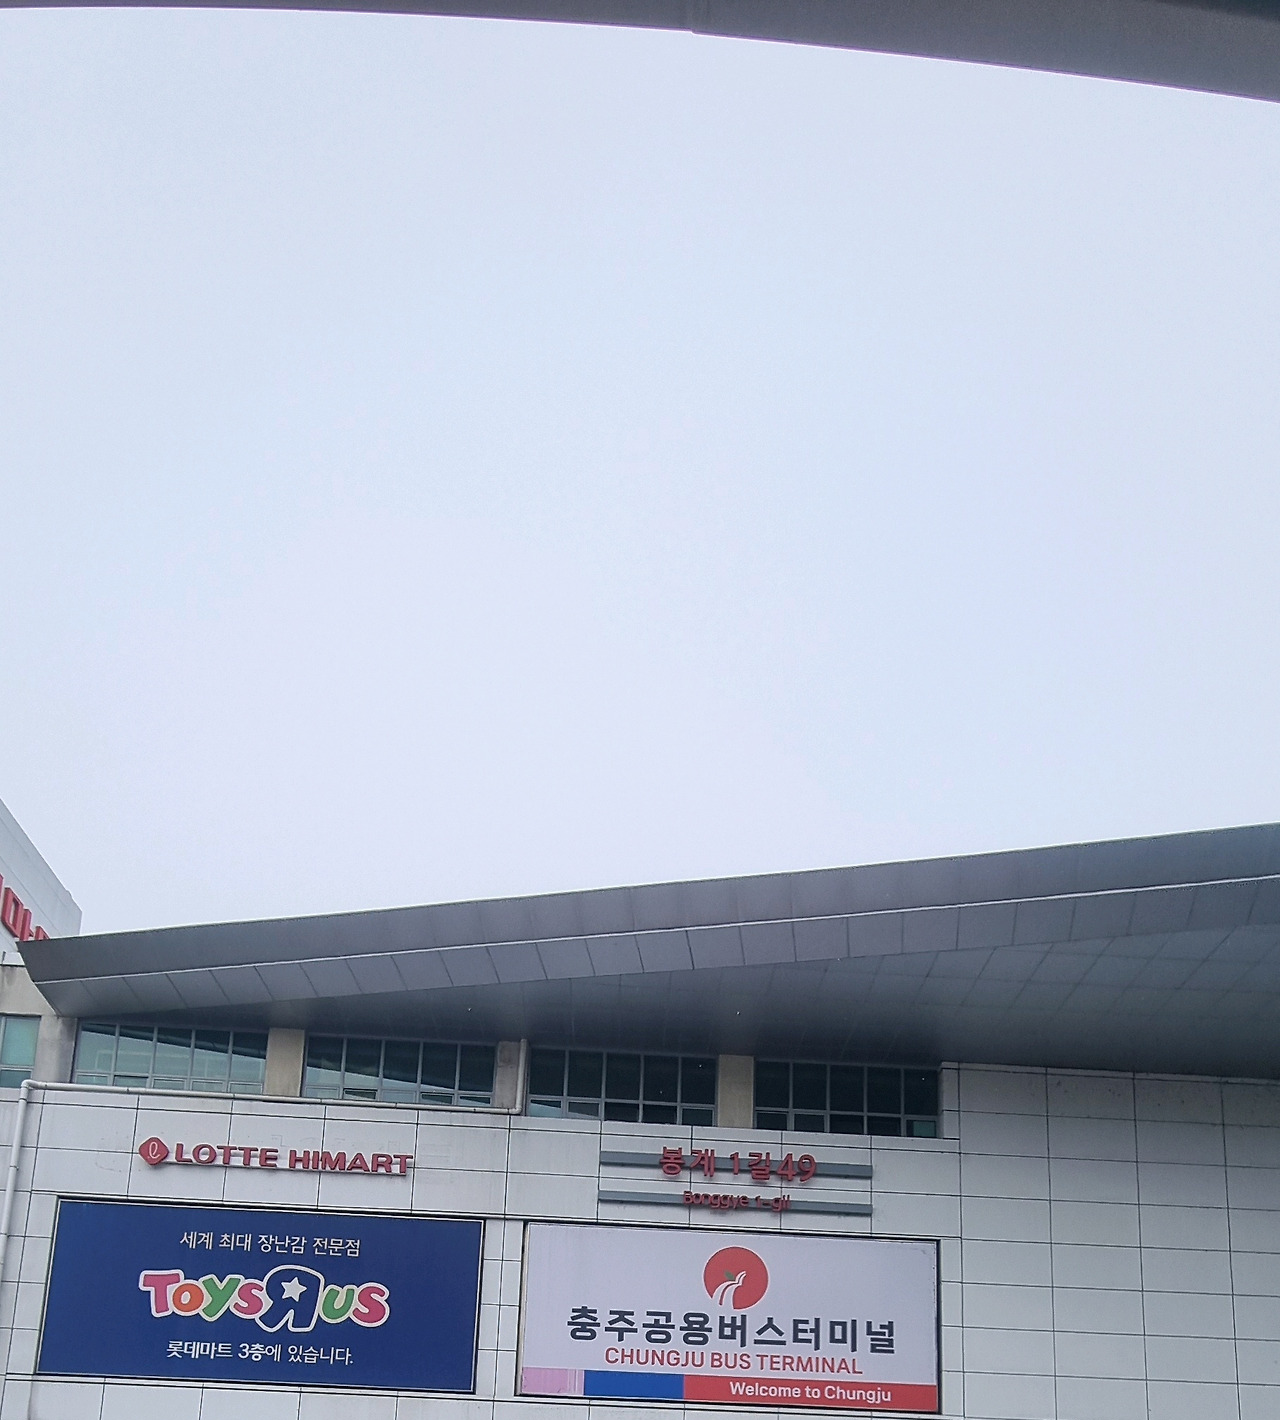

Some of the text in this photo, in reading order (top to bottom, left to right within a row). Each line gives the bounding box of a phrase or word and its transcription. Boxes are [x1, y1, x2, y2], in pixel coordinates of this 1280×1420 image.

[175, 1143, 414, 1174] LOTTE HIMART
[659, 1145, 715, 1178] 봉계
[683, 1190, 791, 1213] Bonggye 1-gil
[179, 1231, 361, 1257] 세계 최대 장난감 전문점
[567, 1305, 896, 1355] 충주공용버스터미널
[166, 1340, 354, 1366] 롯데마트 3층에 있습니다.
[605, 1347, 863, 1375] CHUNGJU BUS TERMINAL
[729, 1381, 892, 1404] Welcome to Chungju
